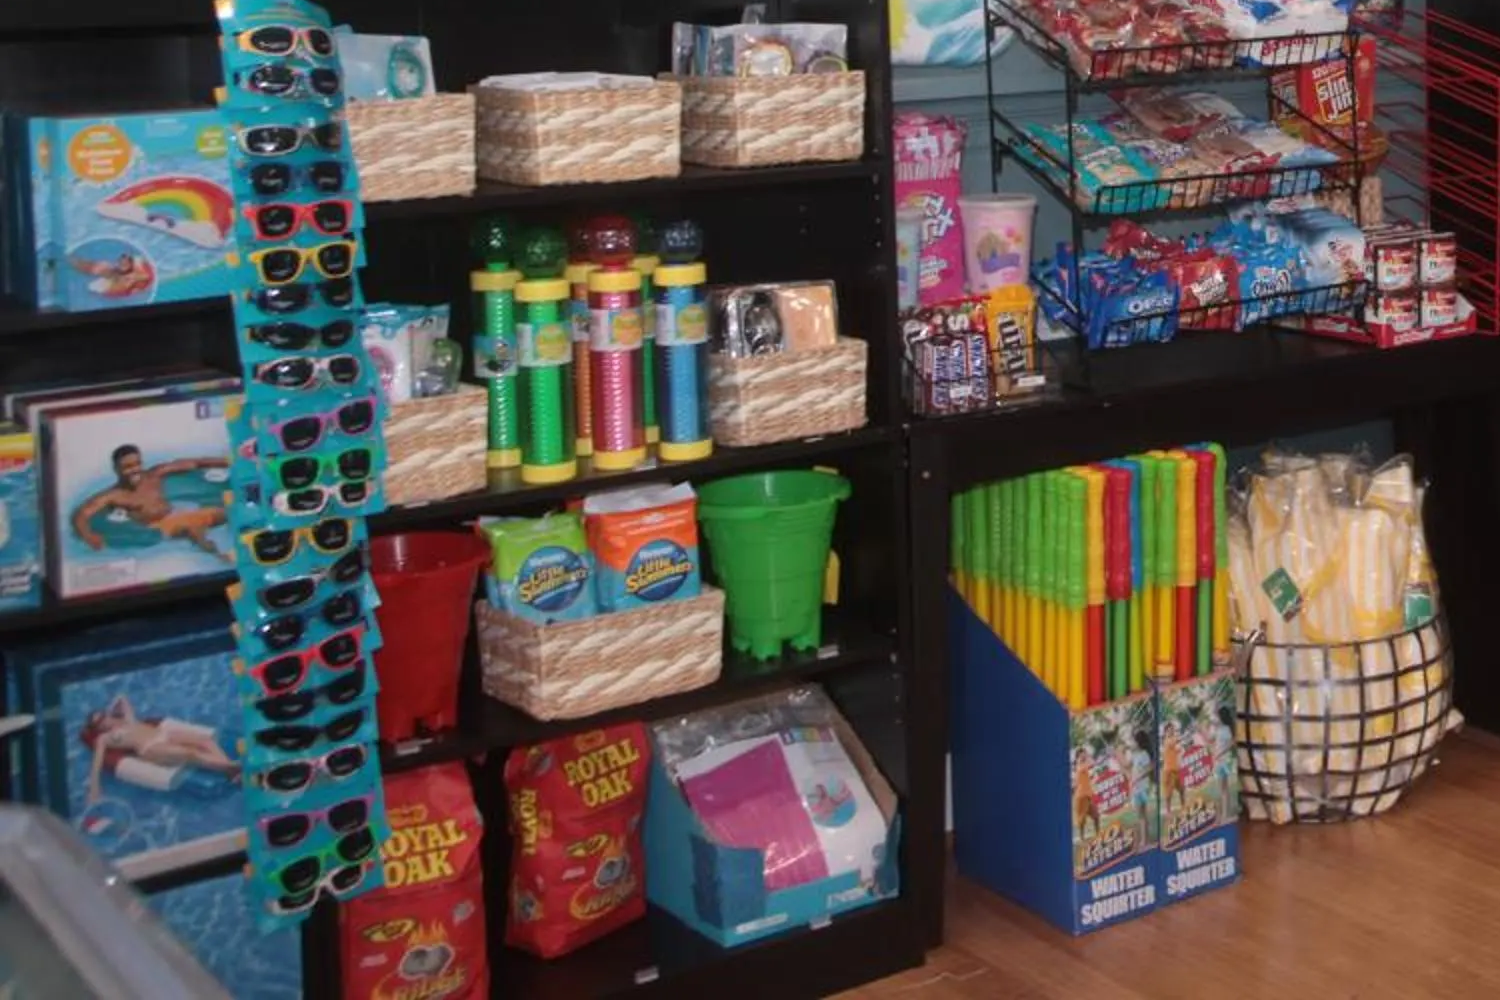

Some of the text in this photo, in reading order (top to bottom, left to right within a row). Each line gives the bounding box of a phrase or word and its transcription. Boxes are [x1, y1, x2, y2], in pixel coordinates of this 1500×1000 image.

[563, 738, 641, 786] ROYAL
[581, 769, 634, 808] OAK
[384, 849, 454, 889] OAK
[1176, 838, 1227, 870] WATER
[1091, 865, 1146, 899] WATER
[1166, 856, 1236, 896] SQUIRTER
[1080, 884, 1156, 926] SQUIRTER
